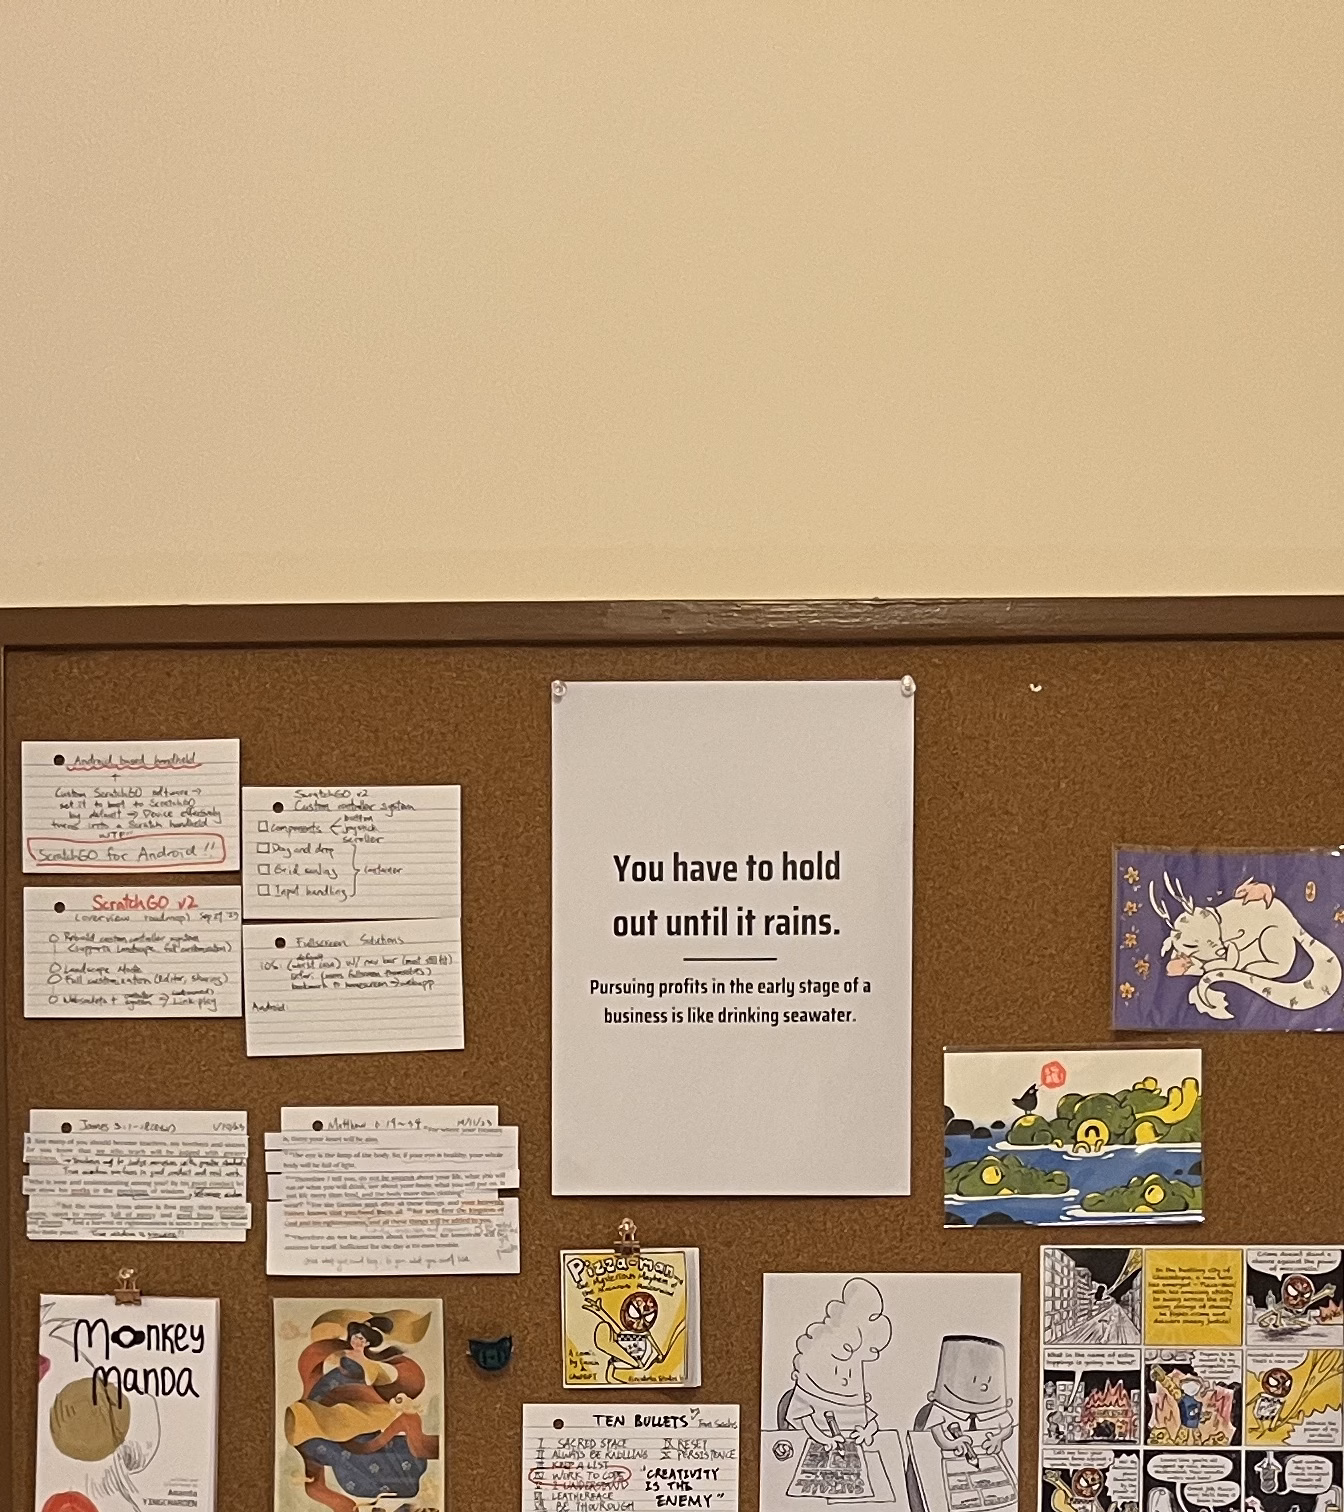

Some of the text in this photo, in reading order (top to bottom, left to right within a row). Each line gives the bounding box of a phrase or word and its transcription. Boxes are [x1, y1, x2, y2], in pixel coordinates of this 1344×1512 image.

[108, 851, 126, 862] for
[138, 847, 196, 862] Android
[613, 850, 840, 882] You have to hold
[178, 895, 198, 910] v2
[613, 905, 840, 936] out until it rains.
[590, 977, 871, 997] Pursuing profits in the early stage of a
[605, 1006, 856, 1026] business is like drinking seawater.
[74, 1318, 204, 1362] Monkey
[593, 1415, 689, 1429] TEN BULLETS
[557, 1438, 596, 1449] SACRED
[552, 1471, 582, 1480] WORK
[587, 1472, 599, 1480] TO
[645, 1481, 693, 1492] IS THE
